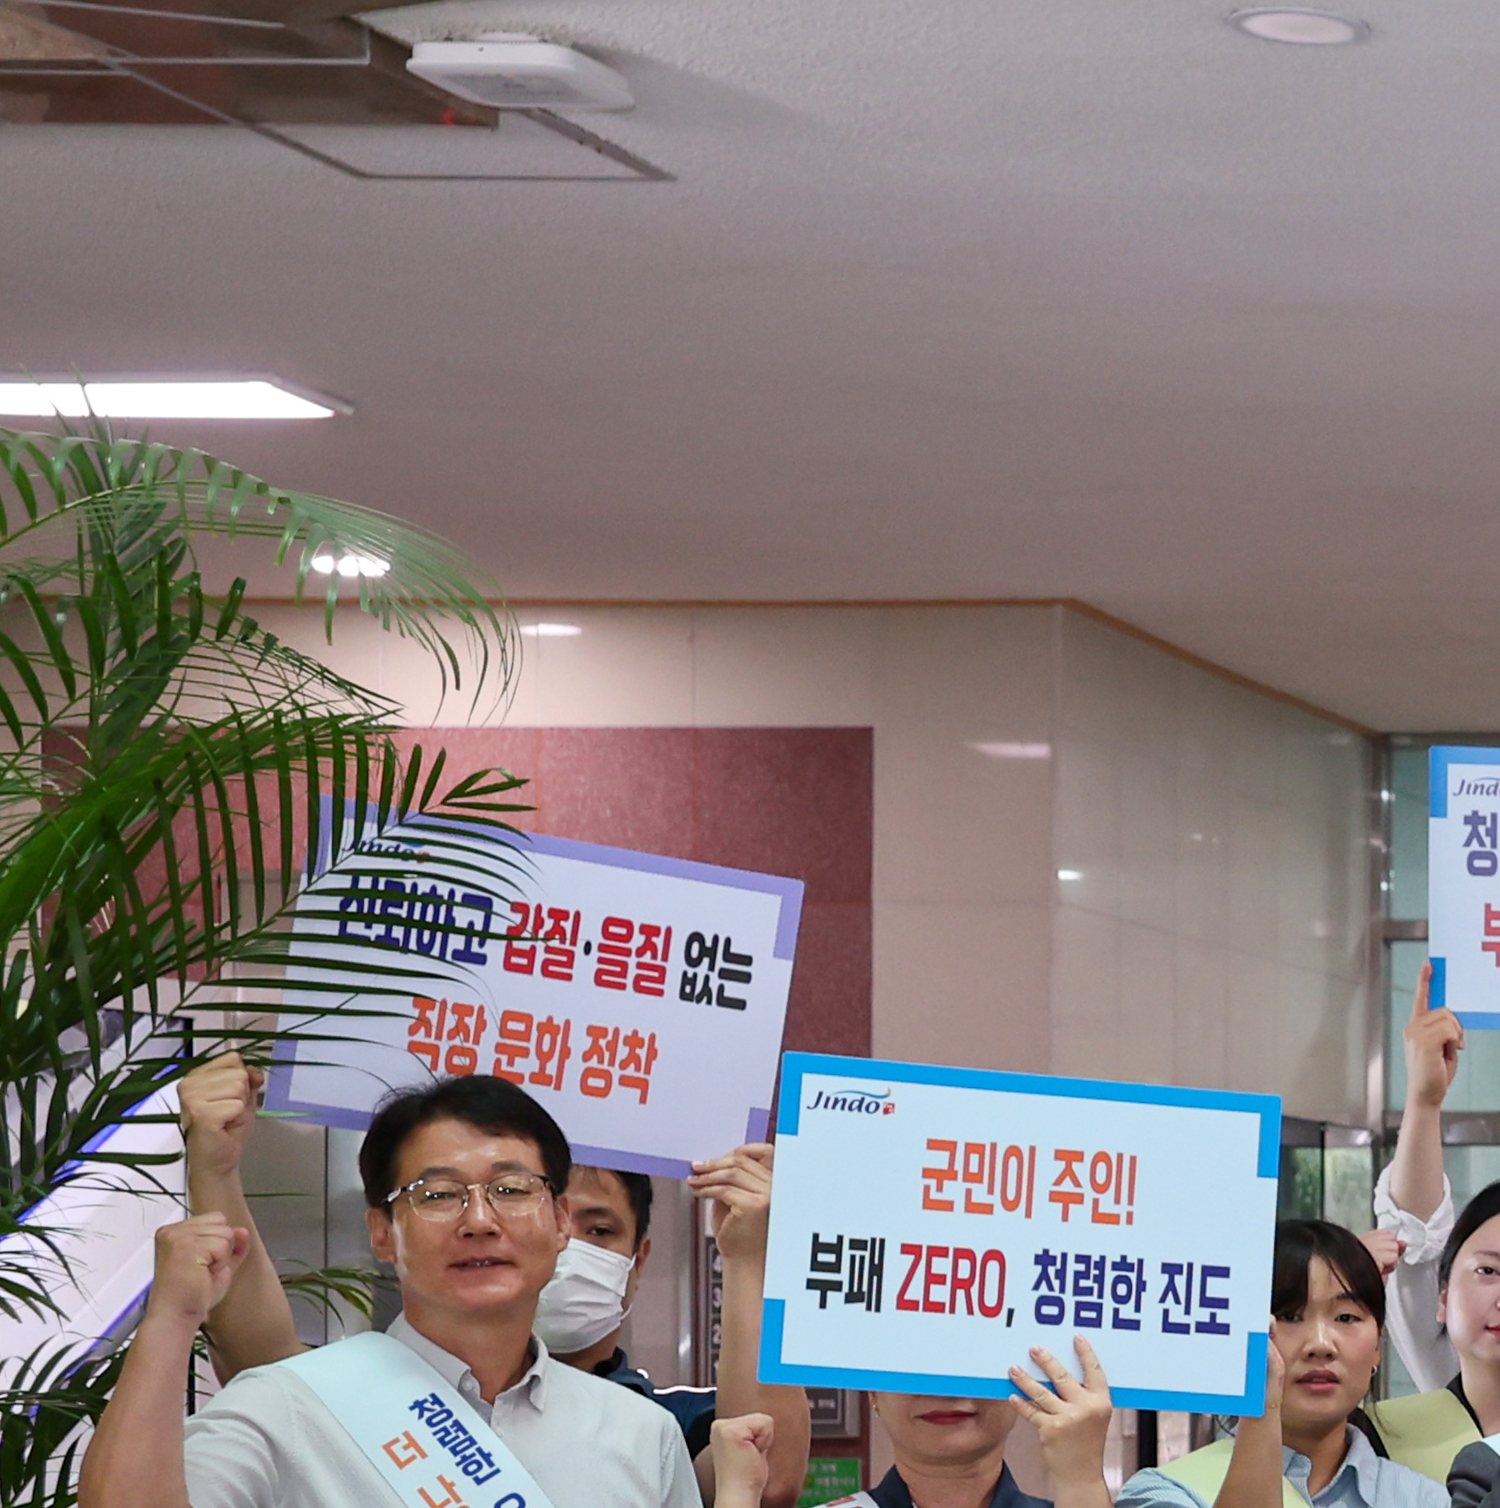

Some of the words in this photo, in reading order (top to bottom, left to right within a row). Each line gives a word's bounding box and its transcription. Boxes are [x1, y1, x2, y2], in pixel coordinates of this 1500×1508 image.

[338, 872, 494, 967] 신뢰하고
[679, 931, 754, 1012] 없는
[407, 998, 487, 1077] 직장
[493, 1010, 571, 1091] 문화
[579, 1024, 659, 1105] 정착
[807, 1089, 881, 1116] Jindo
[921, 1136, 1037, 1221] 군민이
[1047, 1146, 1139, 1226] 주인!
[805, 1232, 887, 1314] 부패
[896, 1242, 1016, 1329] ZERO,
[1032, 1247, 1147, 1334] 청렴한
[1157, 1260, 1232, 1336] 진도
[408, 1393, 501, 1486] 청렴한
